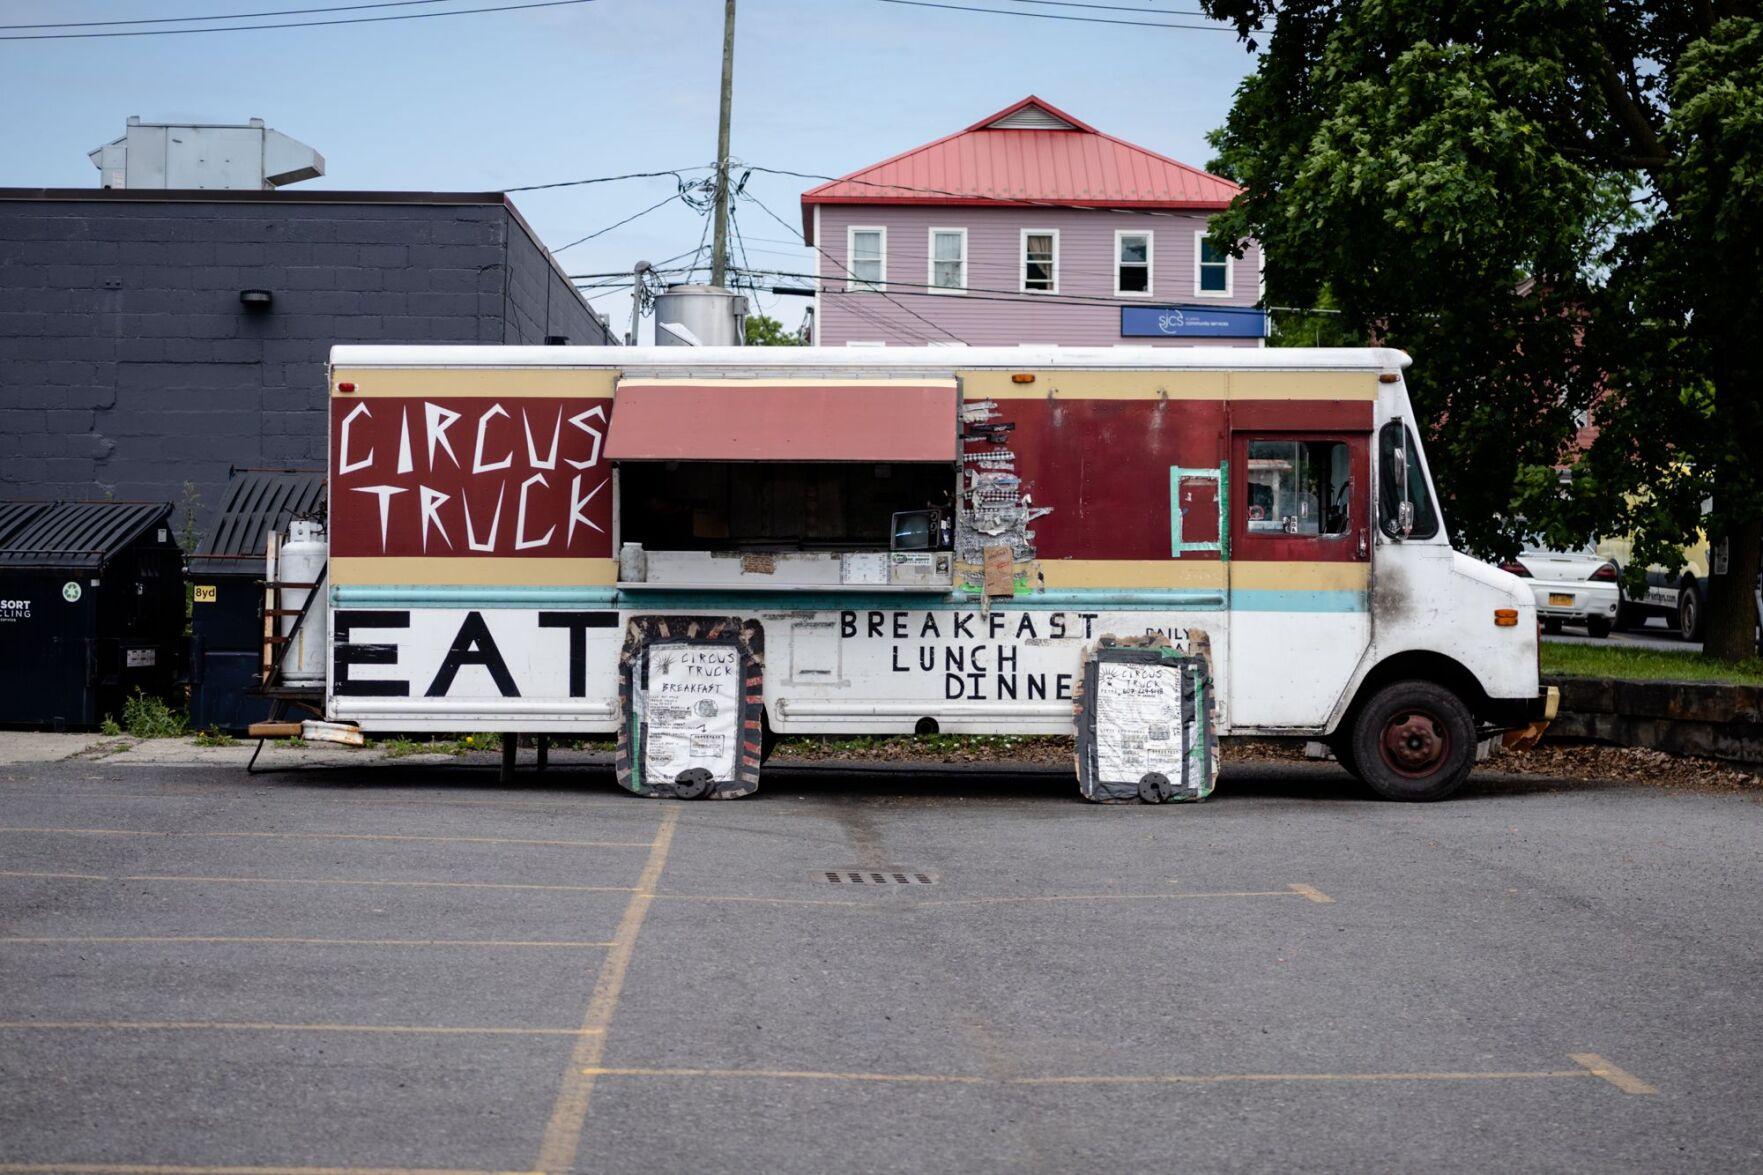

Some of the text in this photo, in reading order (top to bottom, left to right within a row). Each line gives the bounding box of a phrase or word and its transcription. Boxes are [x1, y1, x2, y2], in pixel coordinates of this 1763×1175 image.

[339, 401, 607, 475] CIRCUS
[349, 472, 610, 554] TRUCK
[195, 587, 215, 600] 8yd
[0, 600, 31, 610] SORT
[841, 611, 1099, 639] BREAKFAST
[333, 610, 620, 698] EAT
[681, 653, 735, 664] CIRCUS
[892, 645, 1017, 673] LUNCH
[687, 665, 732, 677] TRUCK
[1122, 669, 1162, 679] CIRCUS
[662, 683, 724, 694] BREAKFAST
[944, 673, 1073, 700] DINNE
